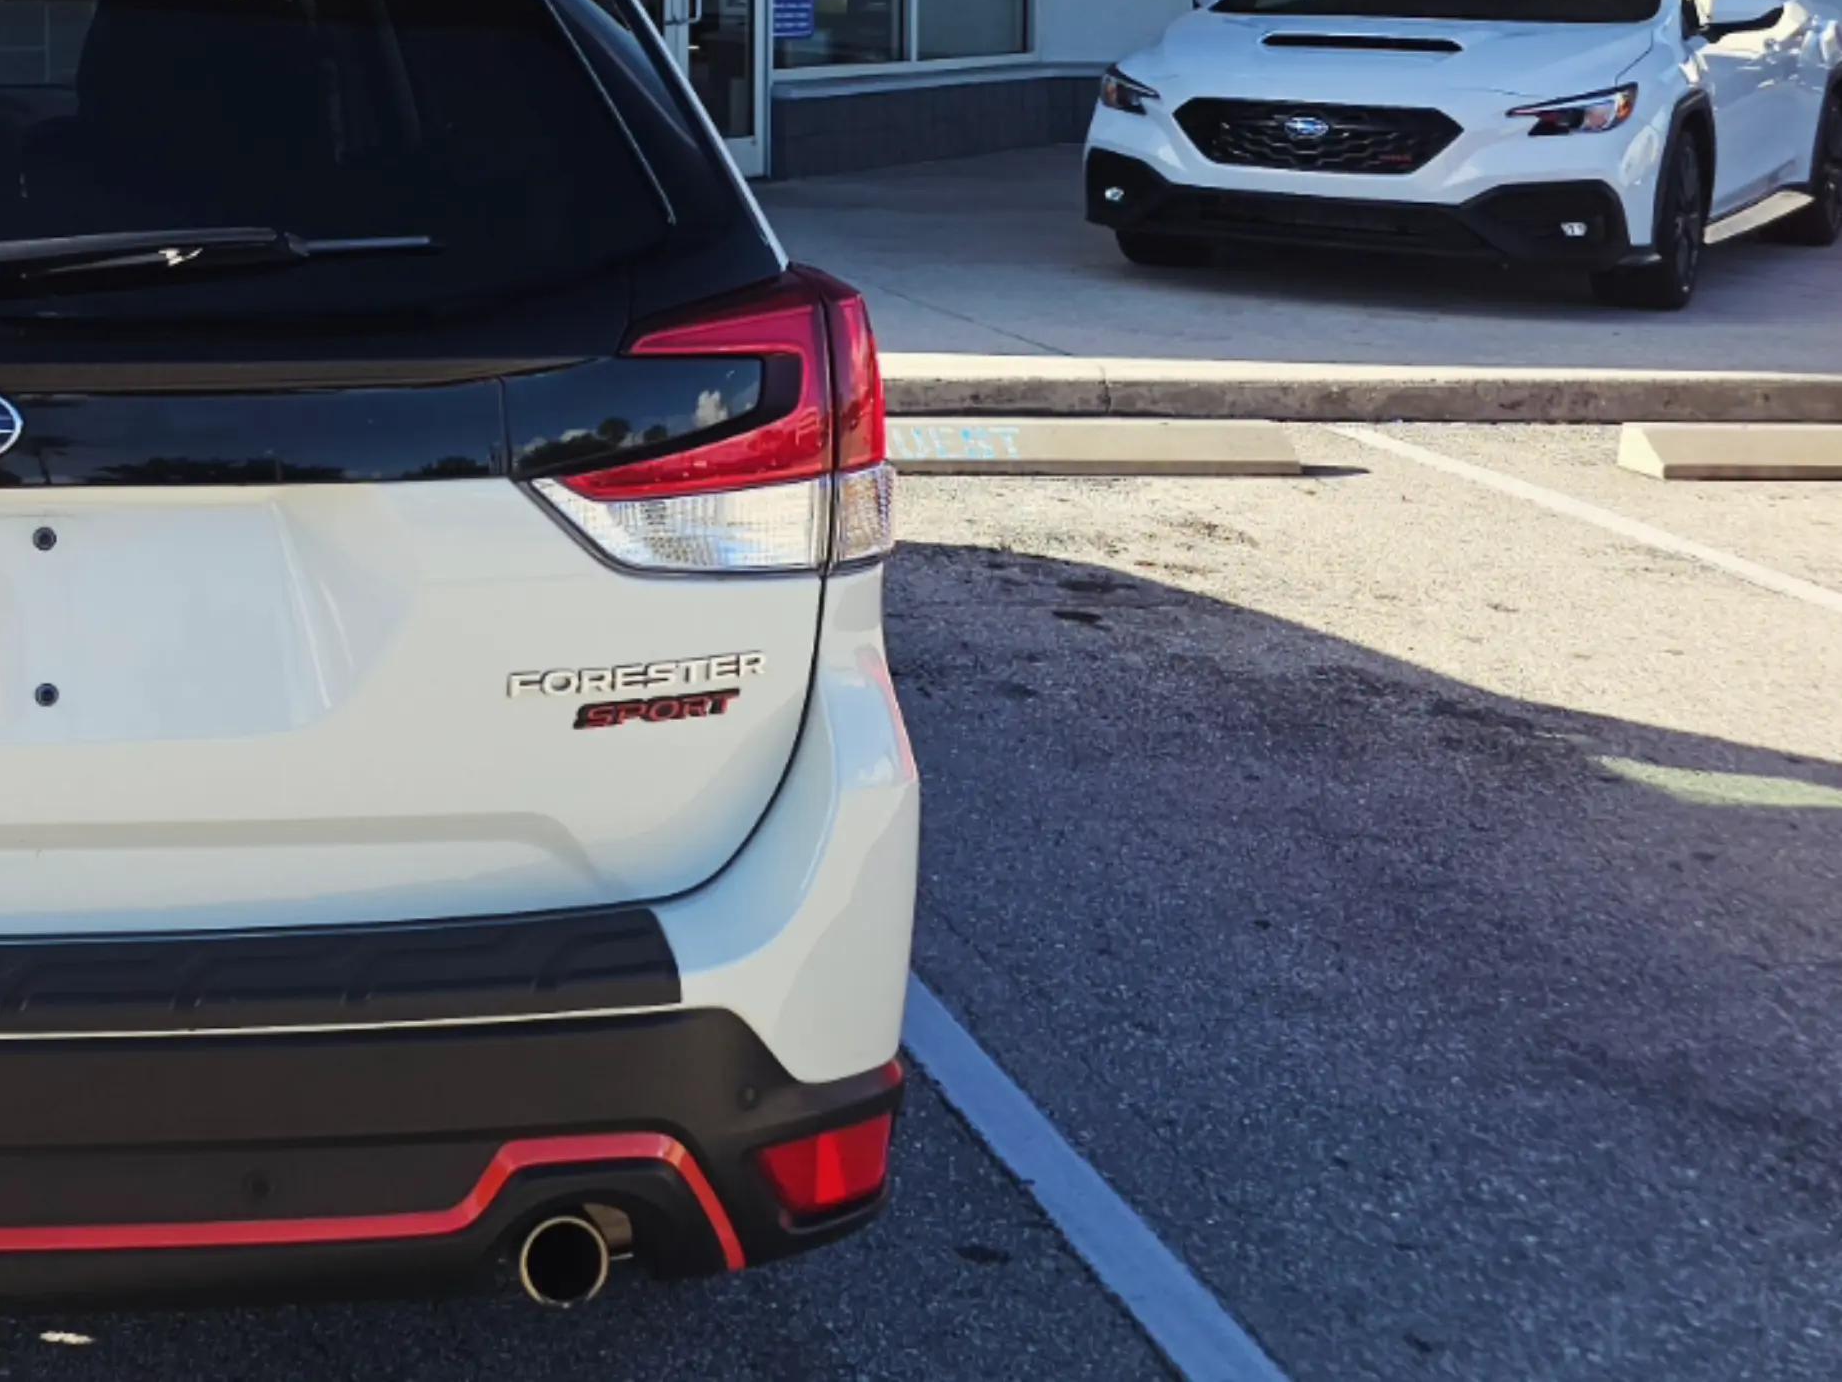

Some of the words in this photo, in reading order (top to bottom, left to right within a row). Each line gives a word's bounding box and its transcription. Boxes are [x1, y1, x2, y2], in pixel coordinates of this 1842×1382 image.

[886, 425, 1021, 460] UEST
[506, 650, 767, 698] FORESTER
[573, 687, 741, 729] SPORT
